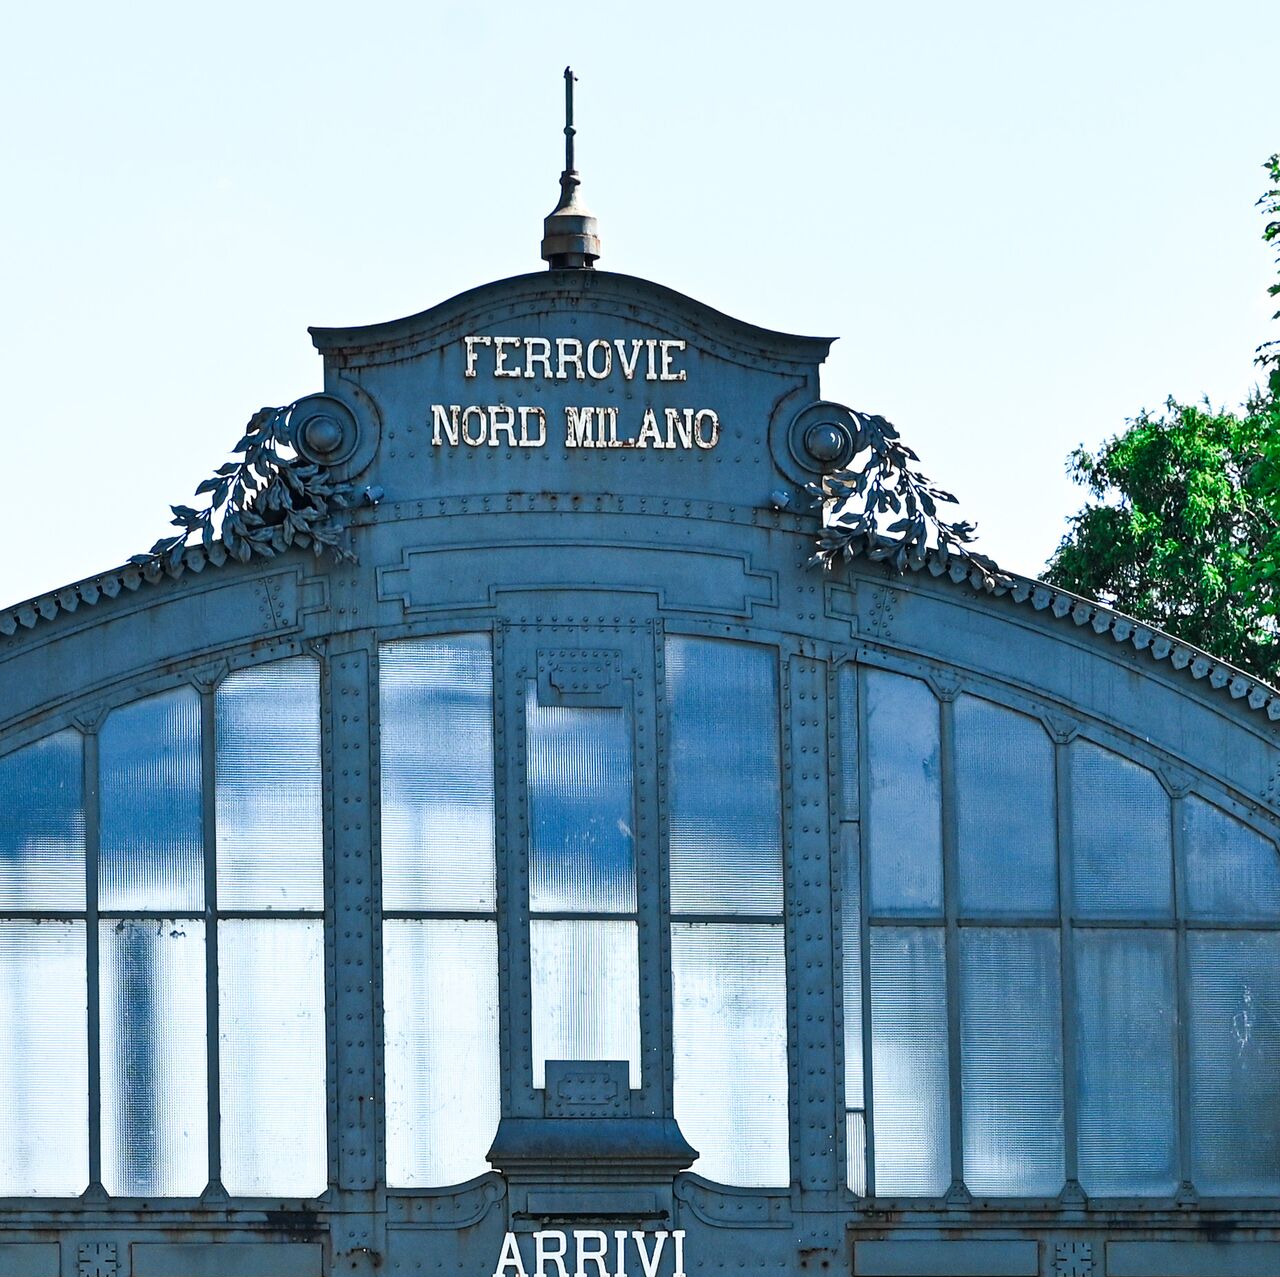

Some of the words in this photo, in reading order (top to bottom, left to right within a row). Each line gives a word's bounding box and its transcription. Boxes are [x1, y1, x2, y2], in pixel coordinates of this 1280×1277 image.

[464, 336, 687, 381] FERROVIE
[431, 404, 547, 447] NORD
[565, 406, 720, 449] MILANO
